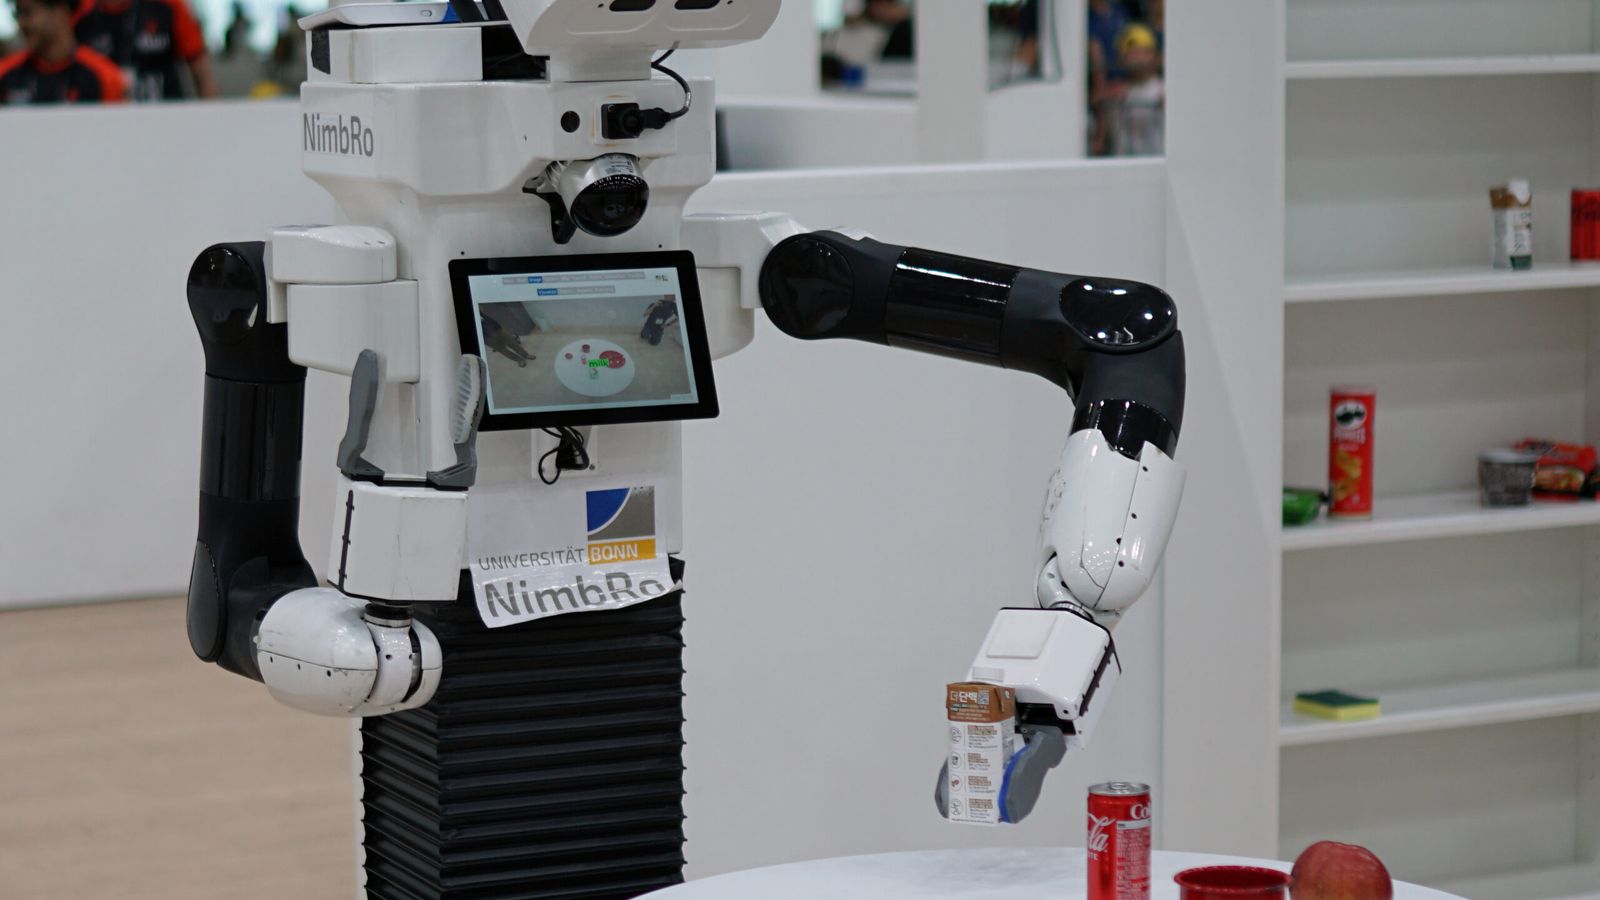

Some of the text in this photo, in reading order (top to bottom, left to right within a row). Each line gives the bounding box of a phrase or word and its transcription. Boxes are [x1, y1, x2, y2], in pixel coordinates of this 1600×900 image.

[303, 112, 374, 157] NimbRo
[588, 359, 608, 367] milk
[478, 543, 639, 571] UNIVERSITÄT BONN
[484, 571, 666, 618] NimbRo
